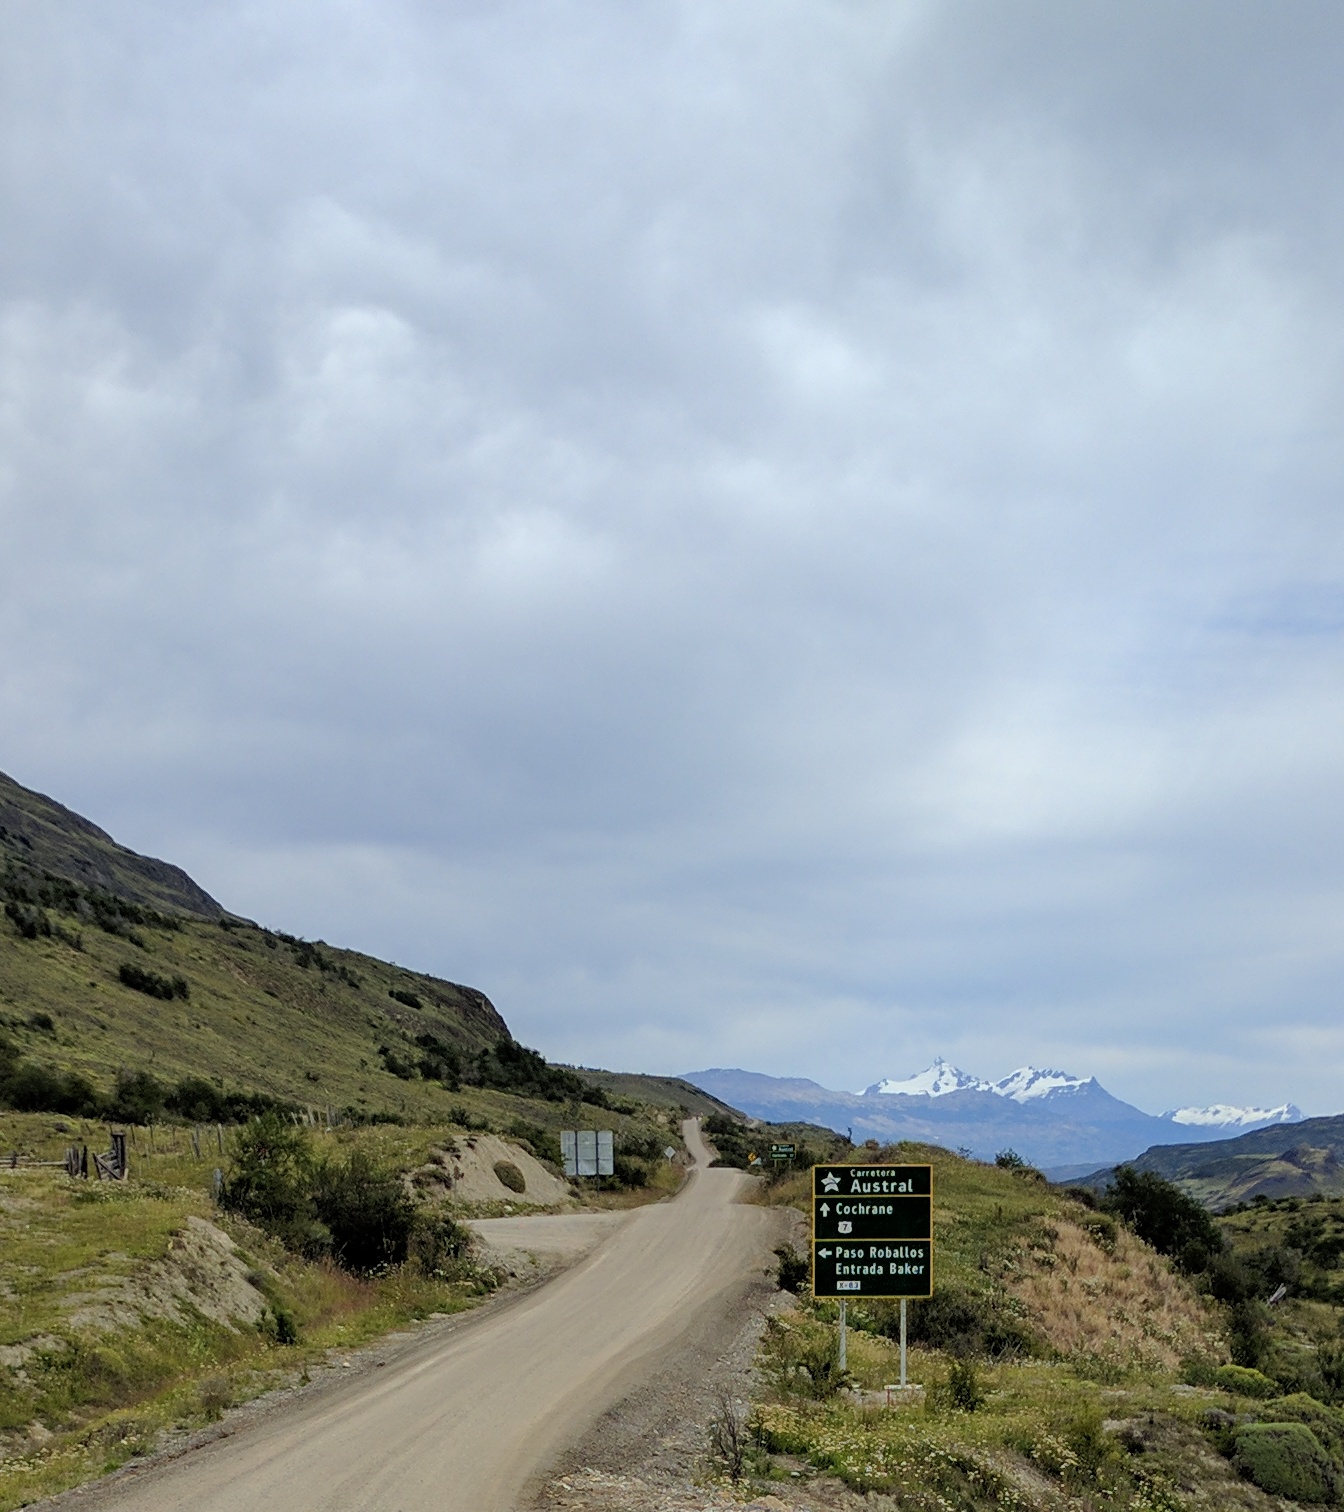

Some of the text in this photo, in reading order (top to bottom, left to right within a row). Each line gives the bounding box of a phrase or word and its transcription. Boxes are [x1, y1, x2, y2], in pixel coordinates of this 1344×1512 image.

[850, 1179, 913, 1193] Austral
[836, 1203, 893, 1215] Cochrane
[842, 1223, 849, 1231] 7
[836, 1246, 924, 1259] Paso Roballos
[836, 1263, 925, 1275] Entrada Baker
